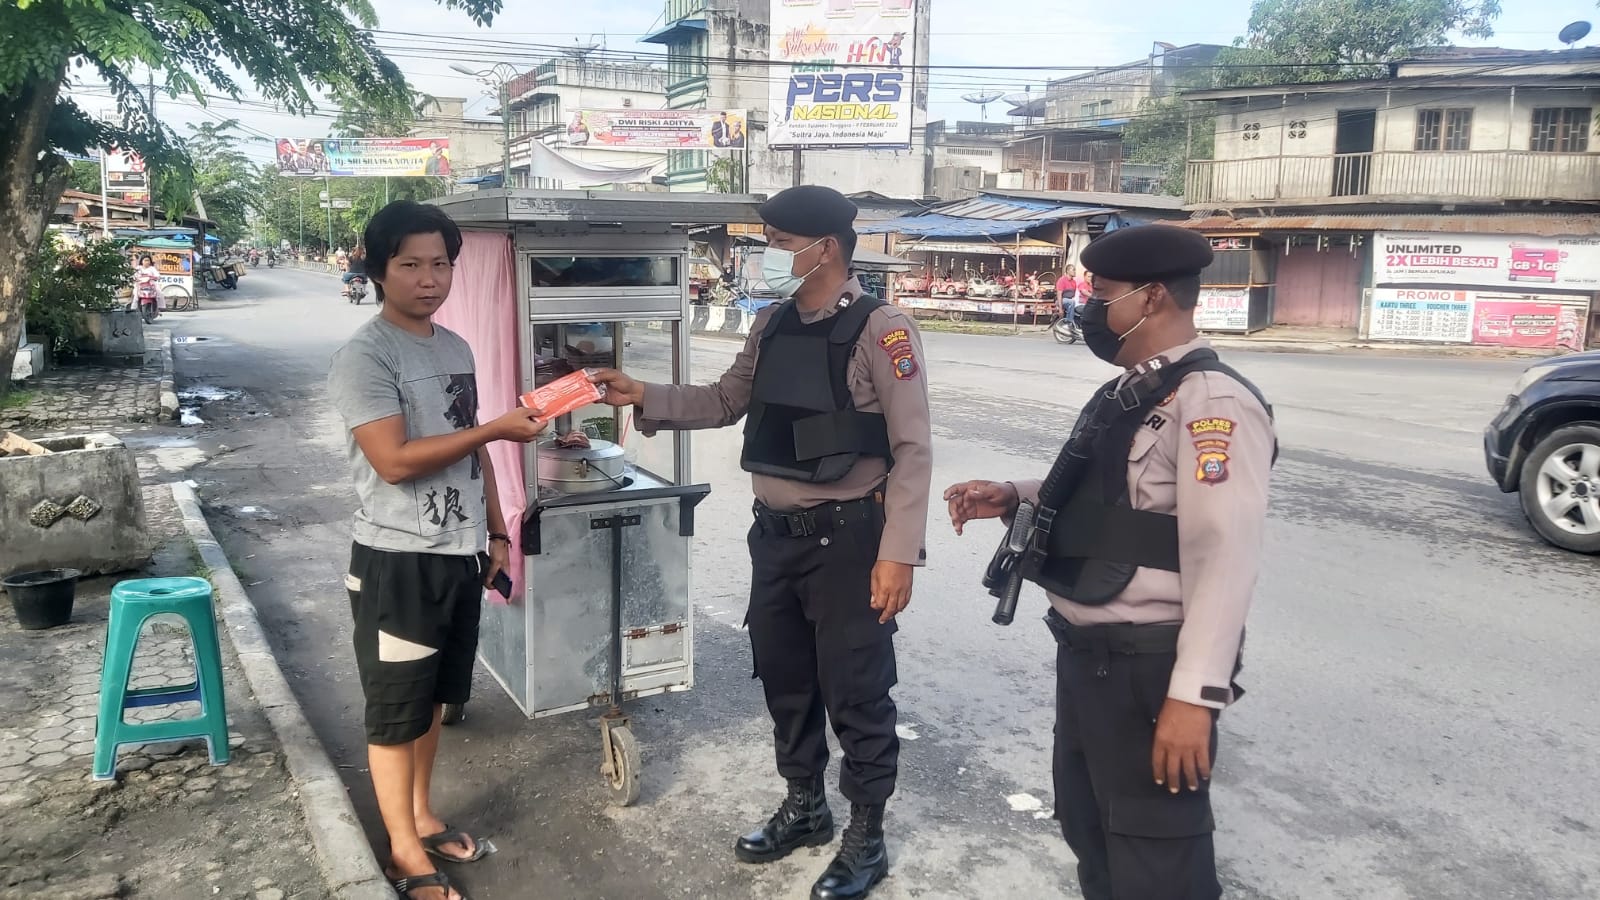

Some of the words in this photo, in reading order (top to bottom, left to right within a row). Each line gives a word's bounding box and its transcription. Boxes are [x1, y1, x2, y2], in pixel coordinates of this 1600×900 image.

[787, 73, 903, 106] PERS
[793, 104, 897, 120] NASIONAL
[663, 119, 694, 127] ADITYA
[1386, 244, 1461, 254] UNLIMITED
[1386, 255, 1408, 267] 2X
[1412, 256, 1450, 266] LEBIH
[1452, 257, 1496, 267] BESAR
[1397, 290, 1450, 301] PROMO
[1207, 297, 1244, 309] ENAK
[883, 330, 905, 343] POLRES
[1192, 418, 1231, 429] POLRES
